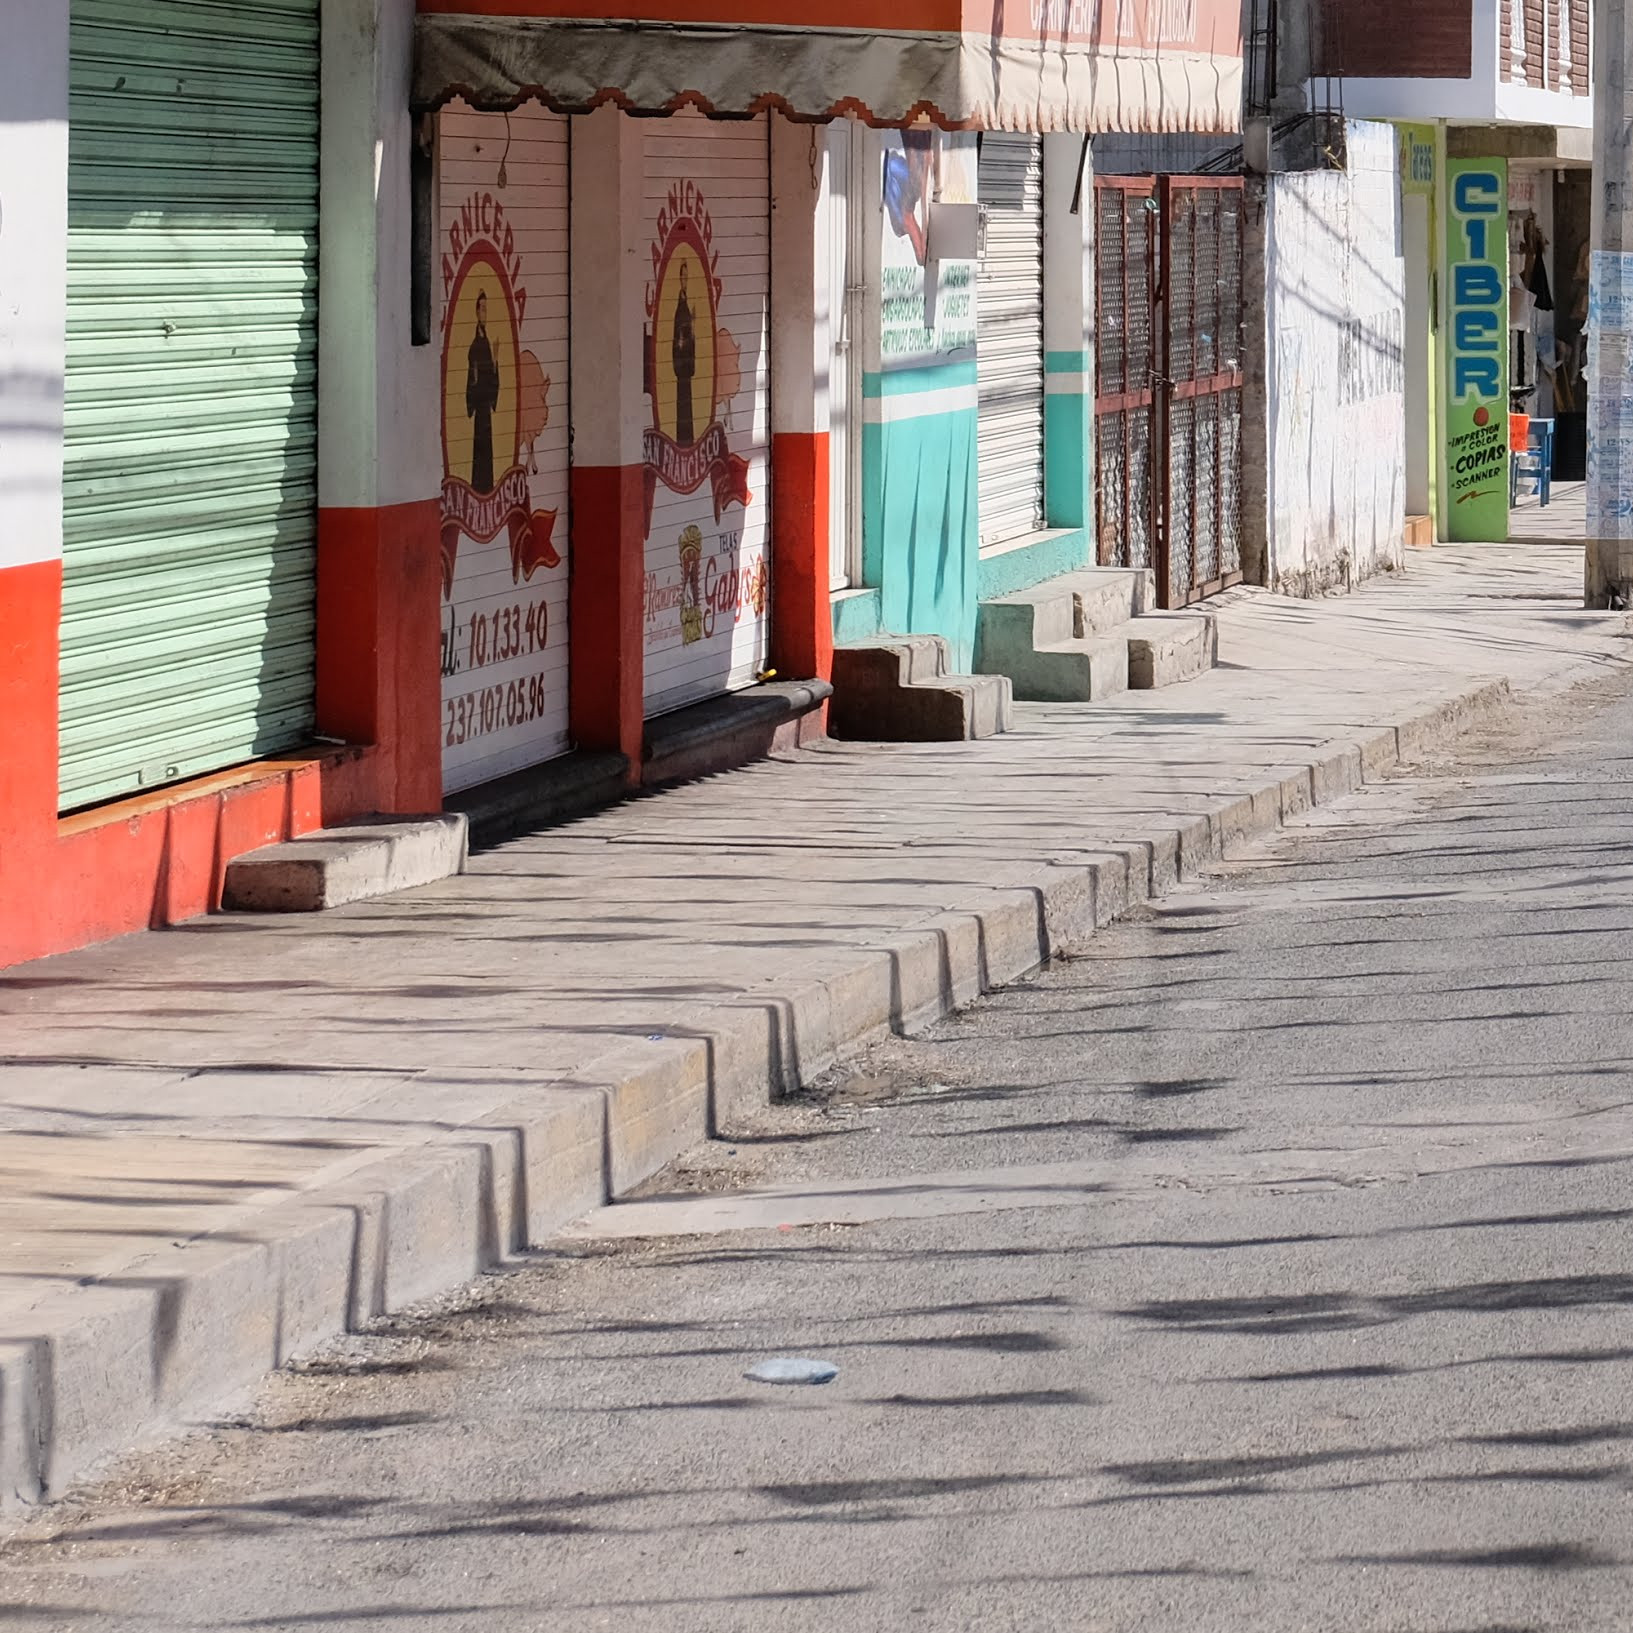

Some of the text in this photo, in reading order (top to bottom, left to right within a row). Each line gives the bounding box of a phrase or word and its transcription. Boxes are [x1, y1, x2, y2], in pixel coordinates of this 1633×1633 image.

[1454, 172, 1502, 398] CIBER
[662, 430, 720, 488] FRANCISCO
[1455, 444, 1506, 474] COPIAS
[1469, 432, 1498, 451] COLOR
[1455, 467, 1501, 489] SCANNER
[466, 475, 527, 535] FRANCISCO
